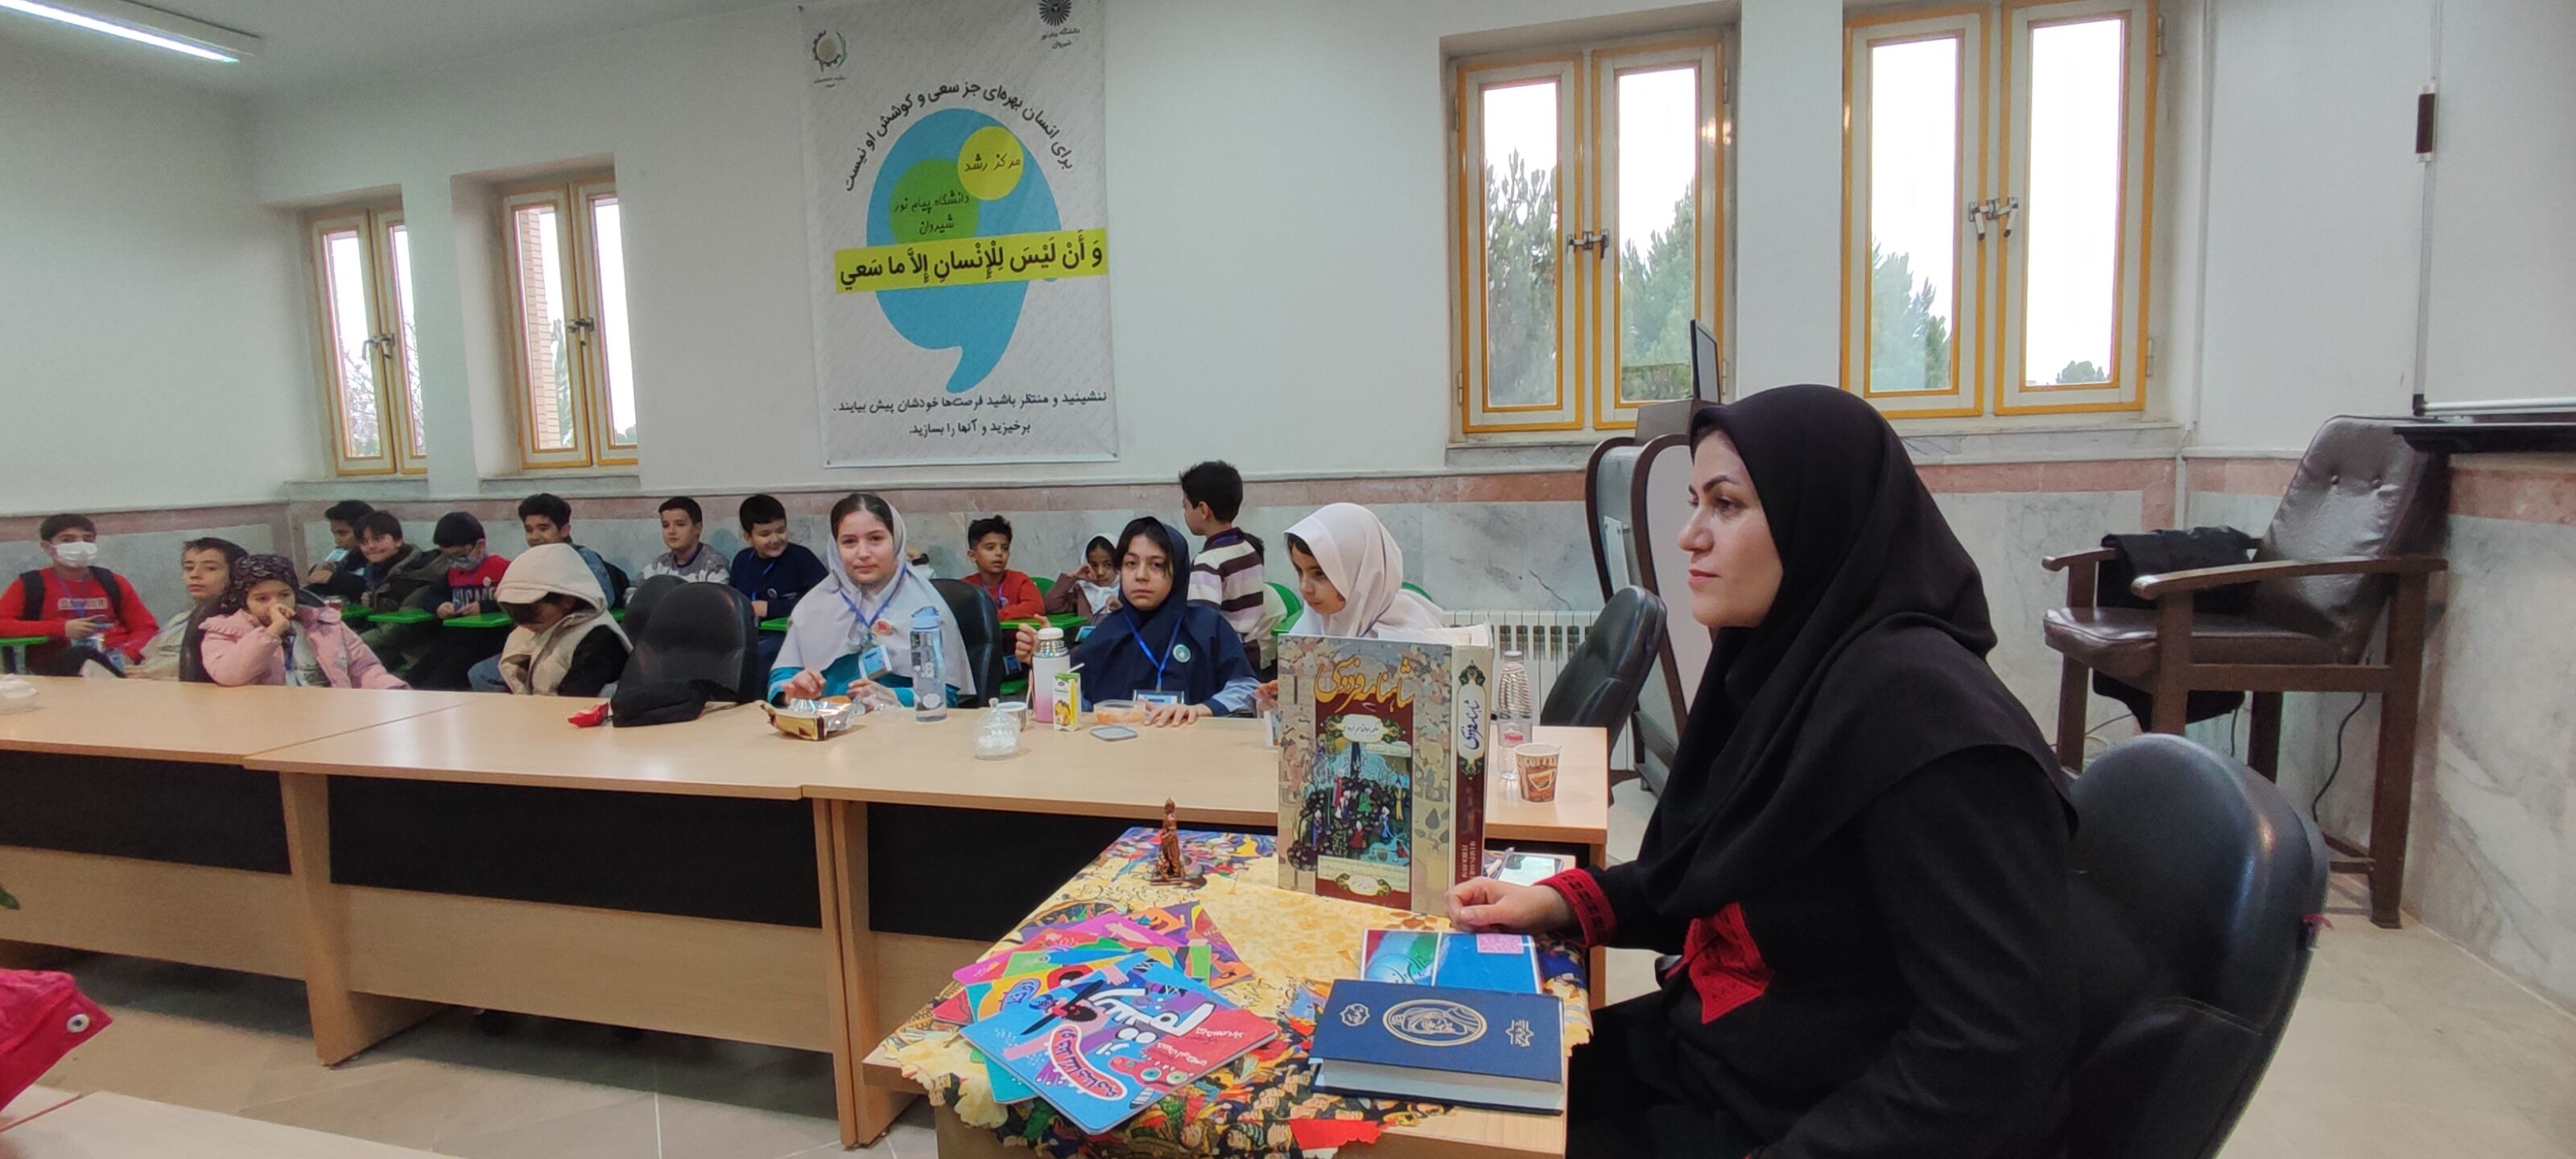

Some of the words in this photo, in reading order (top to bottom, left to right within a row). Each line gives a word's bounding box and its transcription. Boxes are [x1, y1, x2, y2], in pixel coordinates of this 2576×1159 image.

[927, 83, 960, 104] سعی
[962, 81, 980, 99] جز
[917, 94, 926, 108] و
[876, 93, 913, 138] کوشش
[1022, 106, 1060, 140] انسان
[865, 131, 877, 151] او
[964, 154, 989, 172] رشد
[995, 152, 1022, 169] مرکز
[1051, 142, 1073, 170] برای
[844, 147, 868, 192] نیست
[894, 197, 910, 213] نور
[910, 198, 934, 214] پیام
[935, 190, 971, 207] دانشگاه
[919, 215, 956, 235] شیروان
[888, 256, 906, 275] ما
[986, 394, 1016, 406] باشید
[1020, 394, 1049, 409] منتظر
[1052, 397, 1059, 407] و
[1061, 390, 1108, 403] ننشینید
[869, 401, 894, 415] پیش
[897, 398, 939, 413] خودشان
[947, 423, 956, 437] را
[958, 418, 979, 434] آنها
[981, 425, 988, 436] و
[990, 422, 1031, 436] برخیزید
[1313, 654, 1367, 714] فردوسی
[1088, 988, 1216, 1045] رستم
